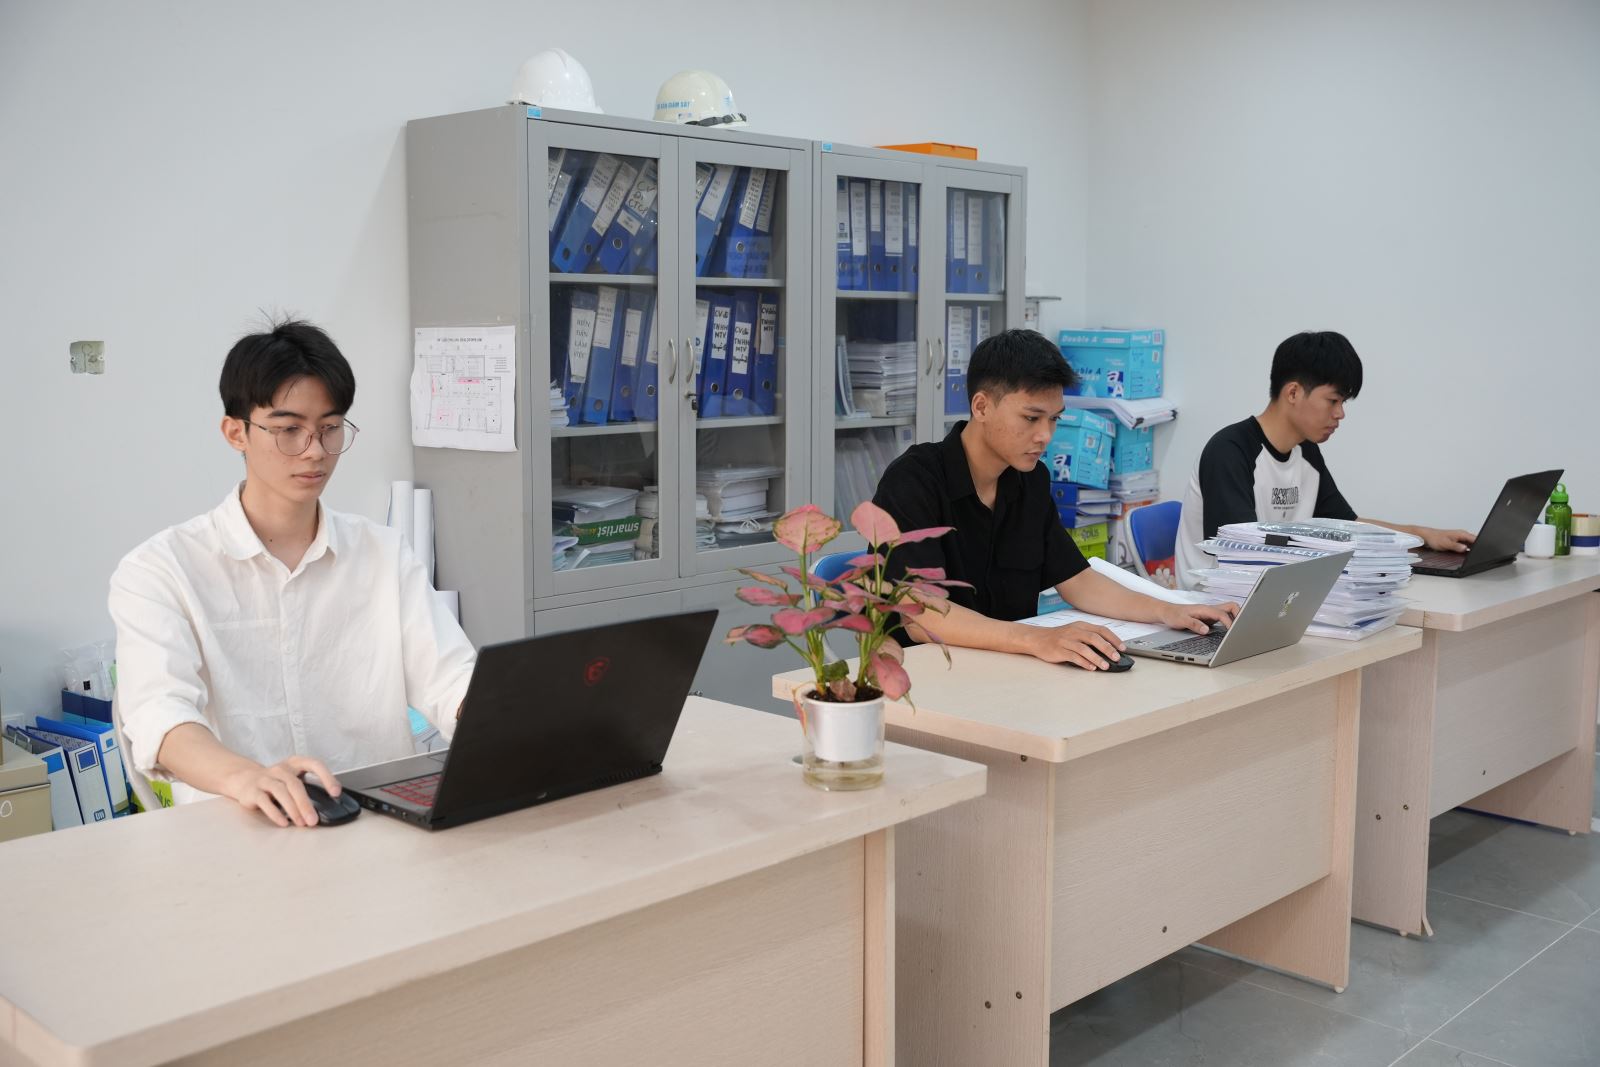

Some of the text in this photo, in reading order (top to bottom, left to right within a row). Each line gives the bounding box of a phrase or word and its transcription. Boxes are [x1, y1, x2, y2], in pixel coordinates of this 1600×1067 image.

[713, 322, 728, 331] TNHH
[715, 331, 727, 339] MTV
[597, 522, 640, 538] smartist
